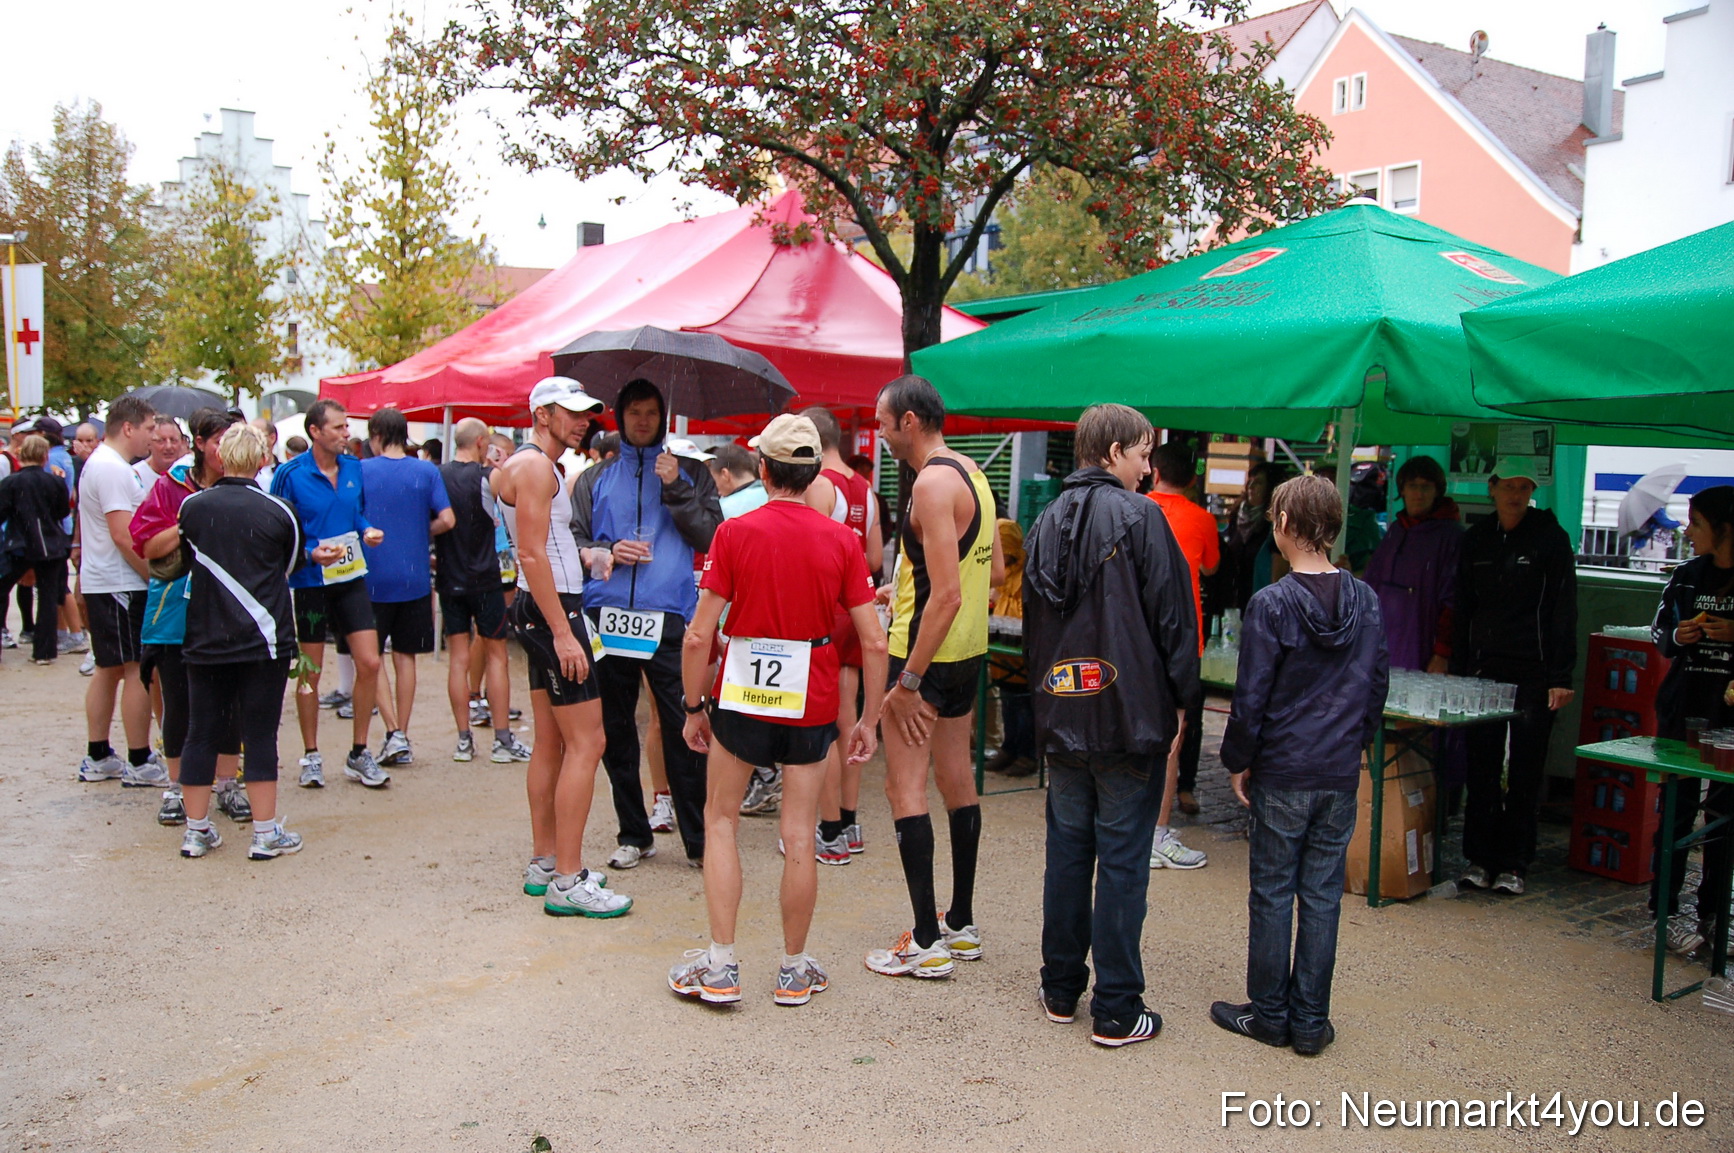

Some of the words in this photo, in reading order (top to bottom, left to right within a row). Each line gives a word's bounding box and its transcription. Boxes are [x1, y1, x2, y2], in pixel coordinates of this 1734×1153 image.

[605, 612, 656, 638] 3392
[750, 658, 782, 687] 12
[742, 690, 782, 705] Herbert
